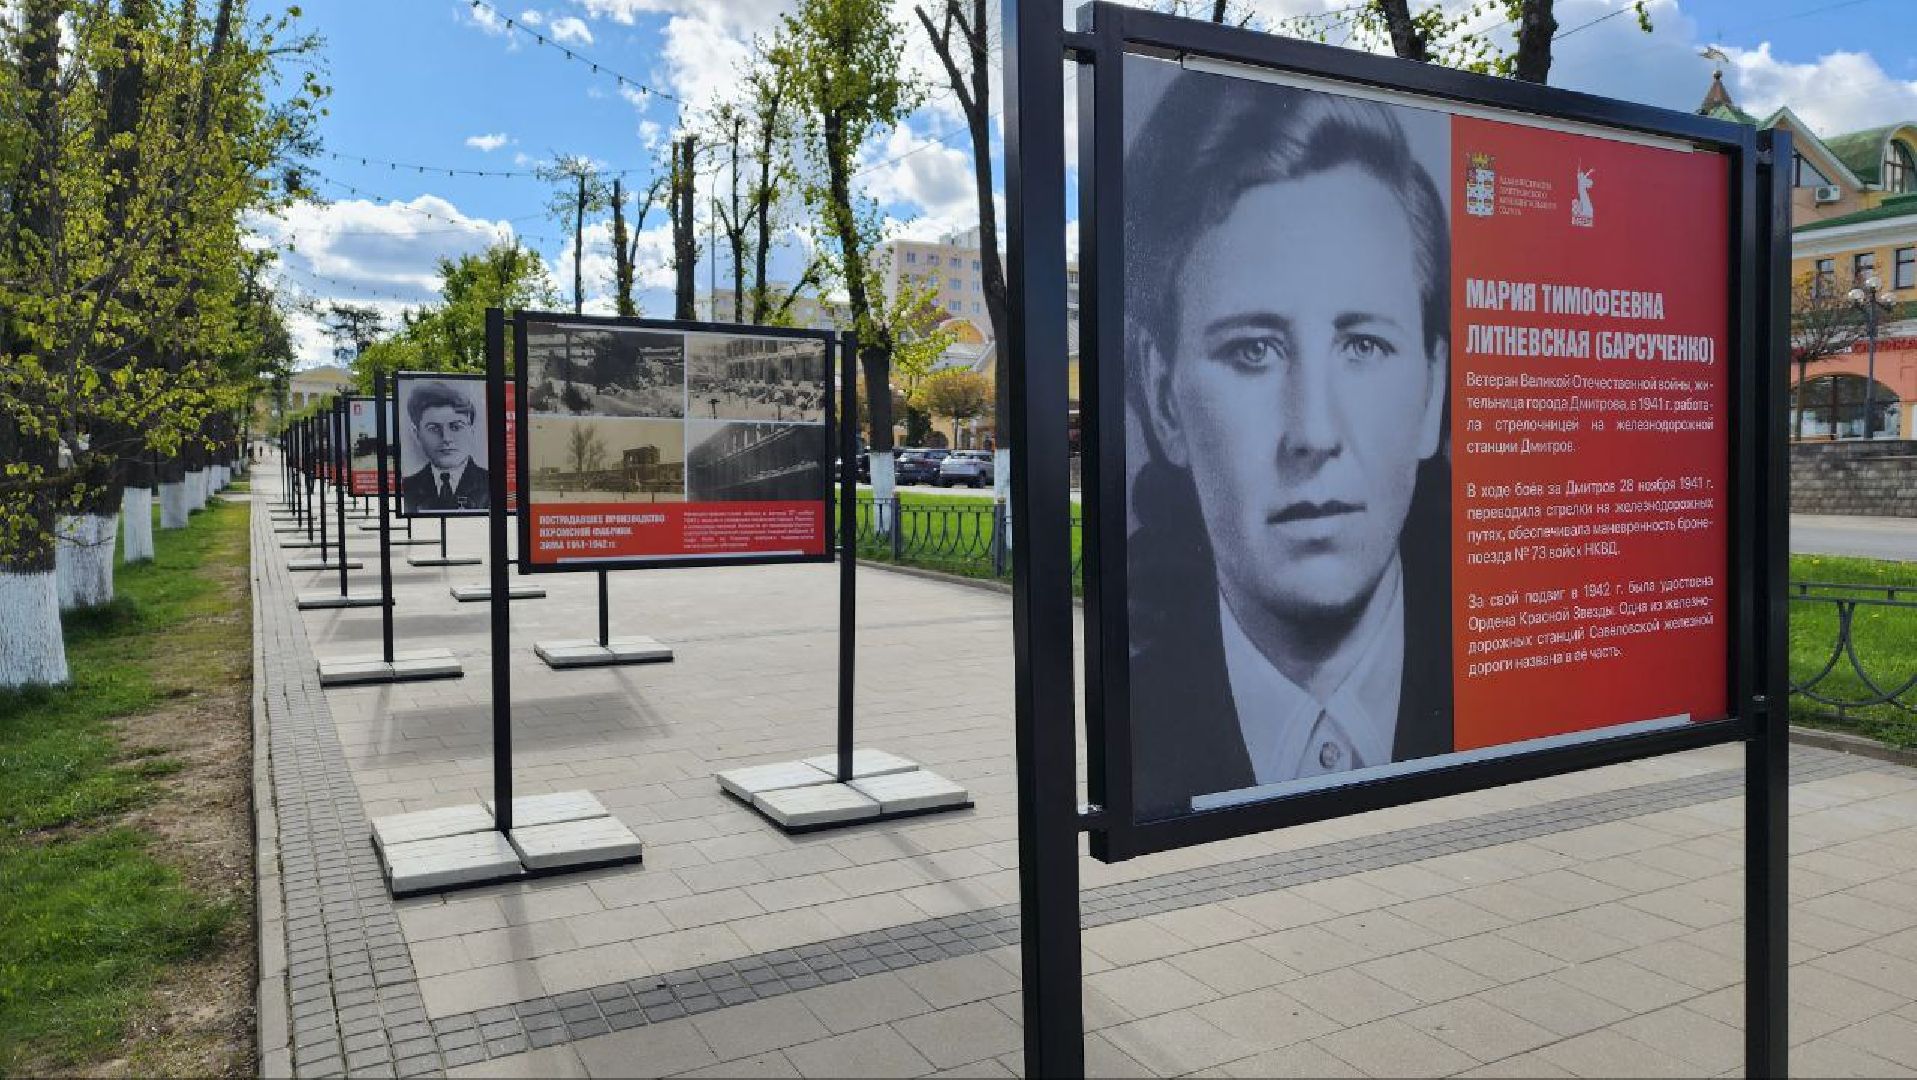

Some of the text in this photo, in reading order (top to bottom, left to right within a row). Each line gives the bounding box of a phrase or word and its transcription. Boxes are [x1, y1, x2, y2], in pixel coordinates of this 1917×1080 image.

[1466, 278, 1665, 320] МАРИЯ ТИМОФЕЕВНА
[1466, 325, 1714, 365] ЛИТНЕВСКАЯ (БАРСУЧЕНКО)
[1467, 372, 1518, 390] Ветеран
[1521, 374, 1570, 389] Великой
[1574, 375, 1656, 390] Отечественной
[1659, 377, 1691, 392] войны,
[1467, 398, 1524, 411] тельница
[1527, 398, 1566, 411] города
[1631, 400, 1636, 410] в
[1638, 398, 1663, 411] 1941
[1467, 417, 1713, 433] ла стрелочницей на железнодорожной
[1467, 441, 1517, 454] станции
[1467, 483, 1476, 497] В
[1482, 486, 1510, 499] ходе
[1548, 484, 1560, 495] за
[1566, 480, 1615, 497] Дмитров
[1620, 479, 1633, 492] 28
[1639, 477, 1675, 493] ноября
[1680, 476, 1702, 489] 1941
[1468, 497, 1713, 521] переводила стрелки на железнодорожных
[1468, 517, 1713, 545] путях, обеспечивала маневренность броне-
[1468, 551, 1511, 564] поезда
[1549, 544, 1581, 559] войск
[1468, 594, 1483, 608] За
[1490, 591, 1518, 606] свой
[1526, 590, 1565, 605] подвиг
[1571, 590, 1577, 599] в
[1584, 584, 1610, 597] 1942
[1629, 580, 1654, 594] была
[1661, 574, 1713, 592] удостоена
[1468, 617, 1515, 632] Ордена
[1520, 607, 1569, 626] Красной
[1620, 601, 1647, 616] Одна
[1651, 601, 1663, 611] из
[1665, 597, 1713, 609] железно-
[1468, 613, 1713, 654] дорожных станций Савеловской железной
[1468, 659, 1512, 678] дороги
[1516, 651, 1562, 668] названа
[1566, 652, 1571, 662] в
